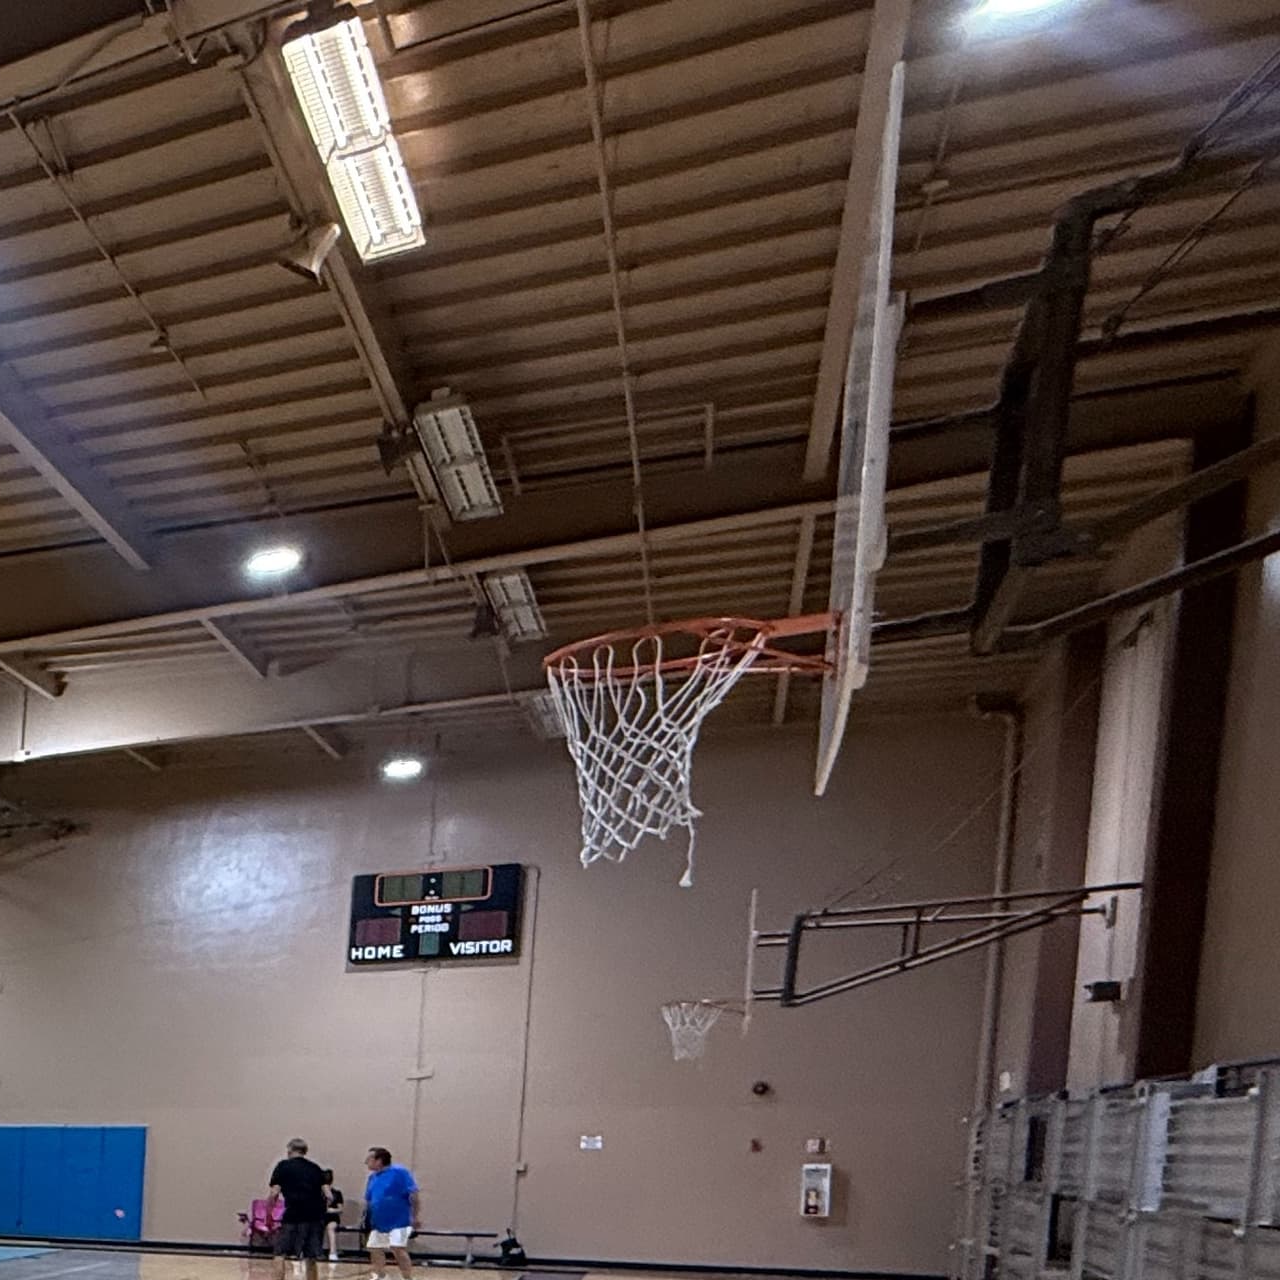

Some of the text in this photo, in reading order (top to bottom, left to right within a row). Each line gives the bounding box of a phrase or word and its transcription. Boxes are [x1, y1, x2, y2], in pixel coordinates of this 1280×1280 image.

[411, 903, 452, 916] BONUS
[410, 922, 449, 934] PERIOD
[351, 945, 404, 960] HOME
[449, 939, 513, 955] VISITOR
